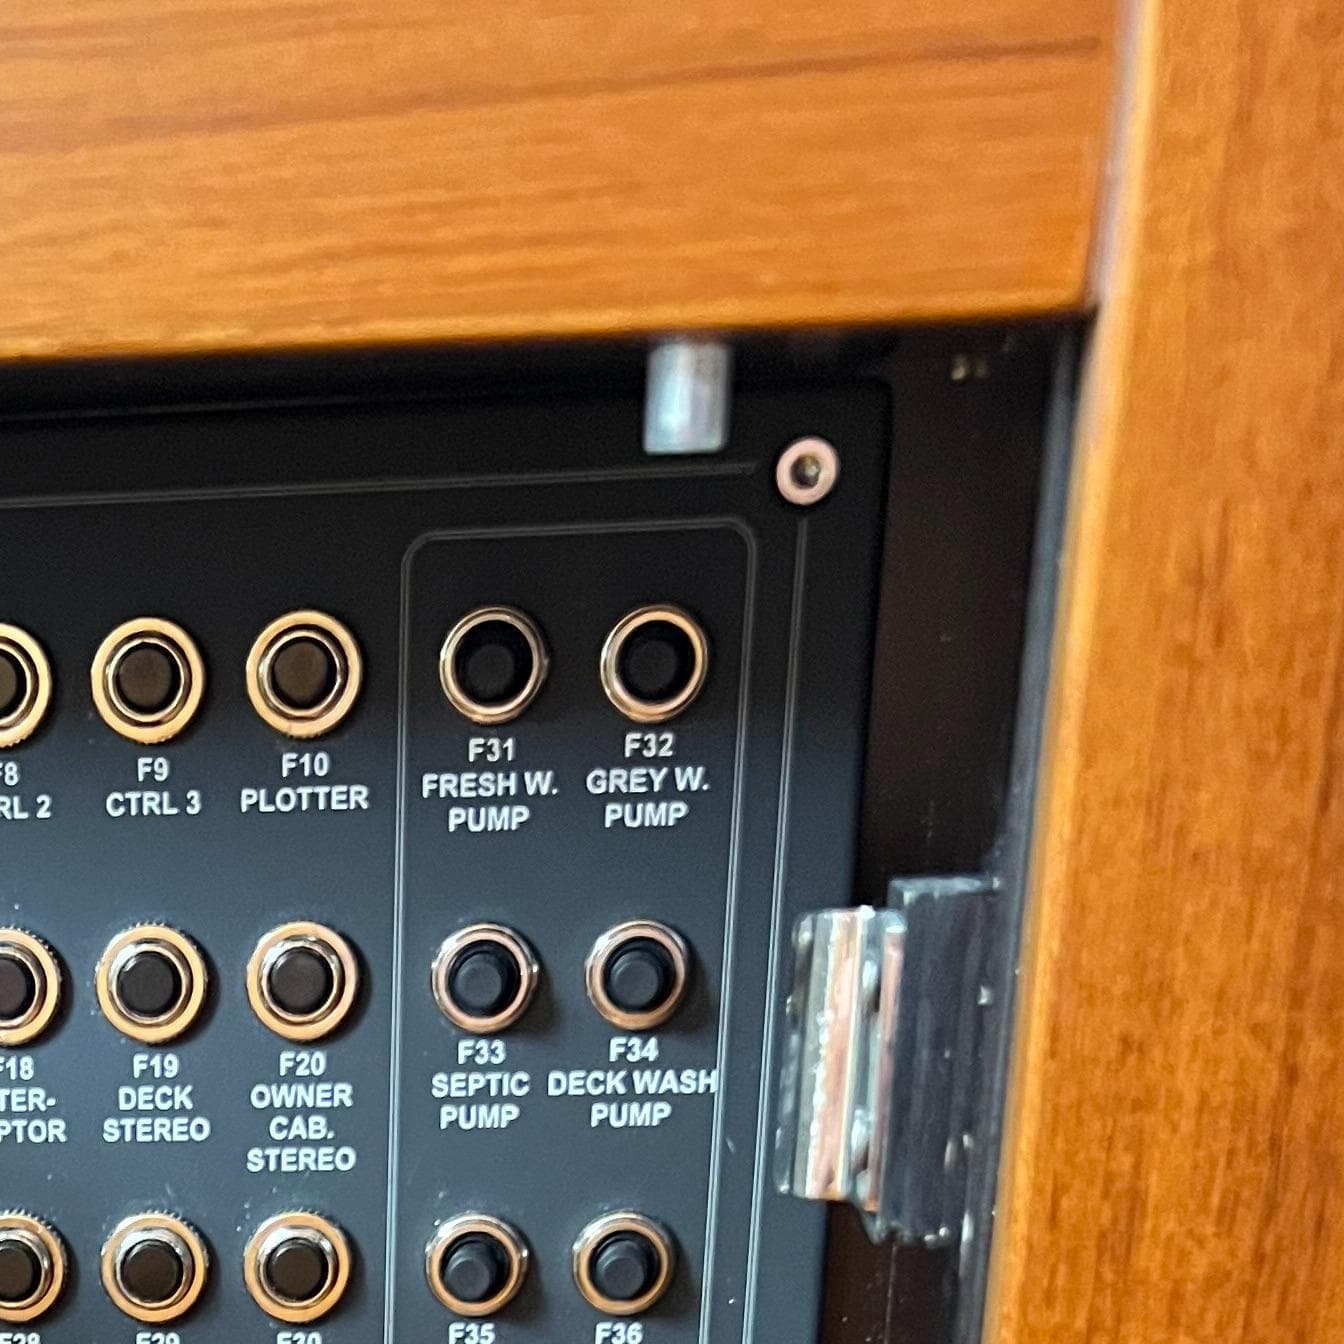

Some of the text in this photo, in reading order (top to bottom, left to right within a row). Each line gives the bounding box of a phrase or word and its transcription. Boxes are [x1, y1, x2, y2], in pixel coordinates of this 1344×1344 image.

[468, 737, 514, 763] F31
[624, 732, 674, 758] F32
[137, 756, 170, 782] F9
[281, 751, 330, 778] F10
[422, 770, 558, 799] FRESH W.
[586, 766, 710, 795] GREY W.
[36, 794, 52, 819] 2
[105, 789, 202, 817] CTRL 3
[240, 784, 369, 813] PLOTTER
[448, 805, 530, 833] PUMP
[604, 801, 688, 828] PUMP
[457, 1039, 507, 1065] F33
[609, 1036, 659, 1063] F34
[133, 1053, 180, 1079] F19
[279, 1050, 327, 1077] F20
[250, 1082, 354, 1109] OWNER
[431, 1070, 531, 1098] SEPTIC
[547, 1069, 717, 1096] DECK WASH
[118, 1084, 194, 1111] DECK
[269, 1114, 335, 1141] CAB.
[440, 1103, 520, 1130] PUMP
[590, 1101, 672, 1128] PUMP
[102, 1116, 211, 1143] STEREO
[246, 1146, 357, 1173] STEREO
